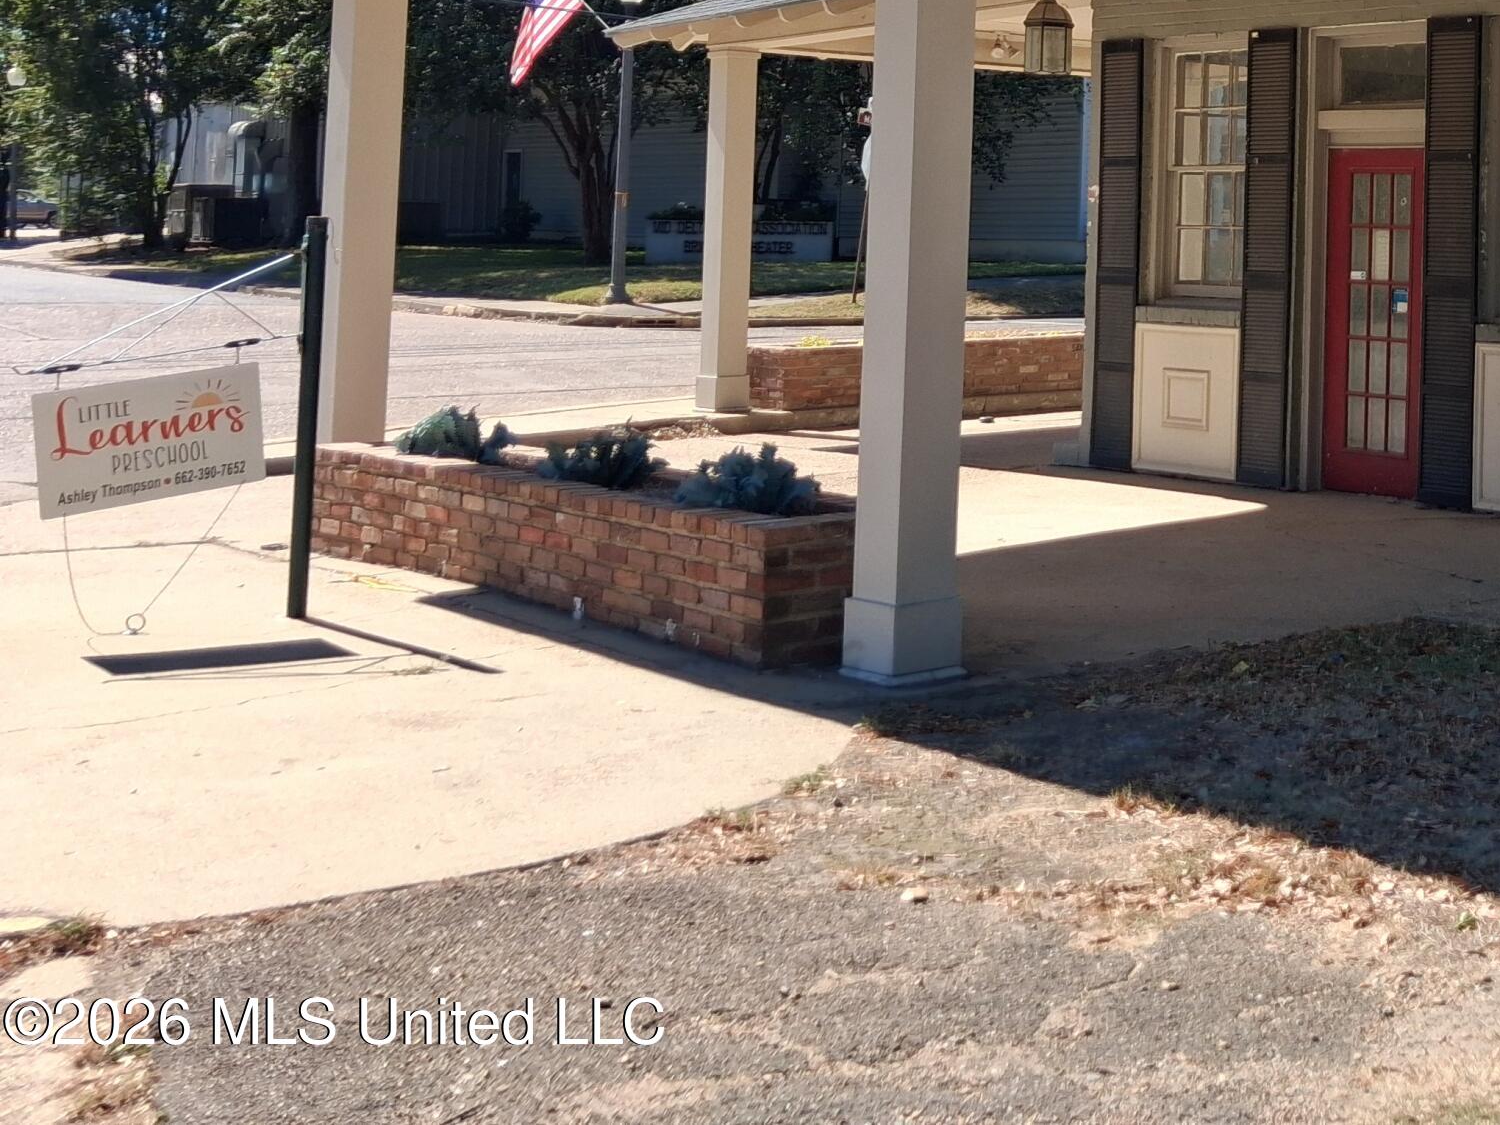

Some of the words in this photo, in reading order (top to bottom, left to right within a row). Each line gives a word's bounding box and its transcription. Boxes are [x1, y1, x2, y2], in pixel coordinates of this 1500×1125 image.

[50, 396, 250, 461] Learners
[78, 399, 131, 423] LITTLE
[111, 440, 209, 474] PRESCHOOL
[57, 488, 98, 506] Ashley
[101, 477, 161, 499] Thompson
[174, 460, 246, 485] 662-390-7652
